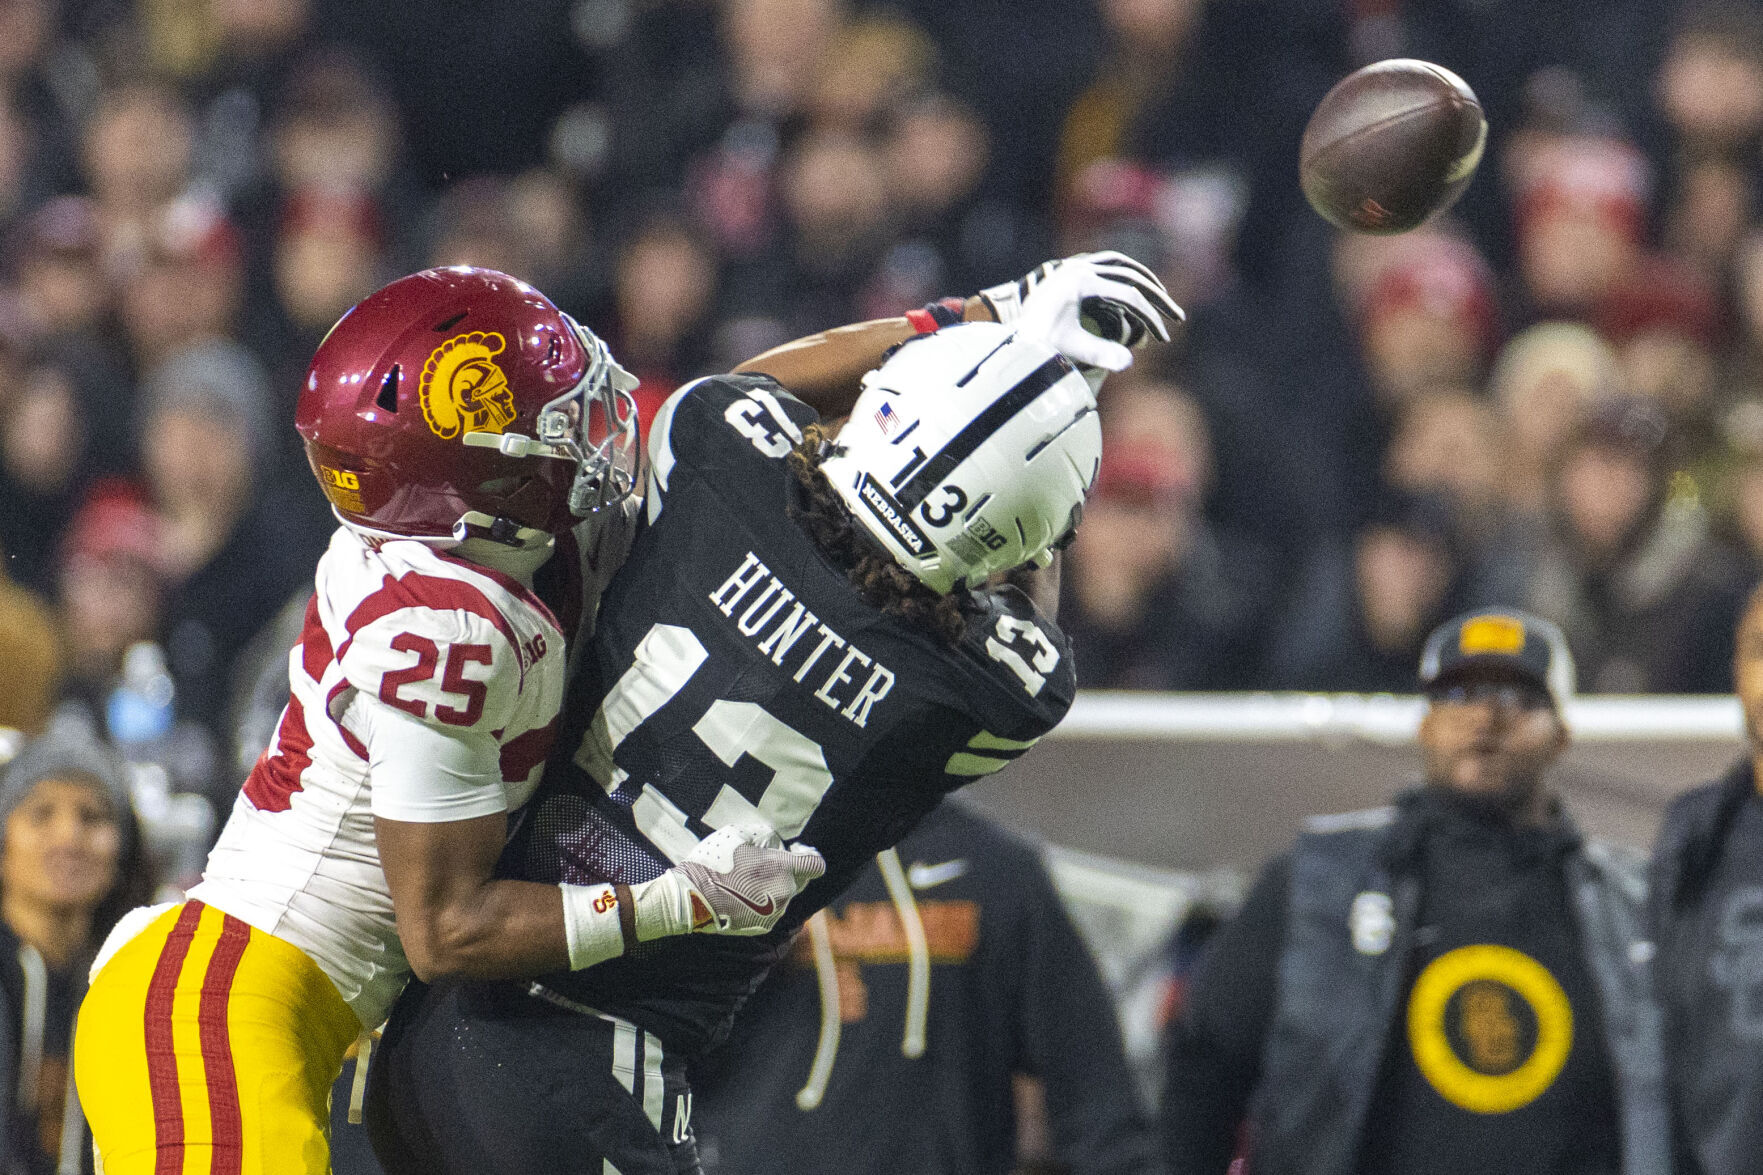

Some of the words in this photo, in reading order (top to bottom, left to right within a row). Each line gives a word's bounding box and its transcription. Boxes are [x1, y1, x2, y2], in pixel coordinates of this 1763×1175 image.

[724, 388, 804, 458] 13
[861, 482, 923, 553] NEBRASKA
[379, 631, 493, 727] 25
[708, 551, 896, 728] HUNTER
[985, 614, 1060, 698] 13
[573, 622, 834, 867] 13
